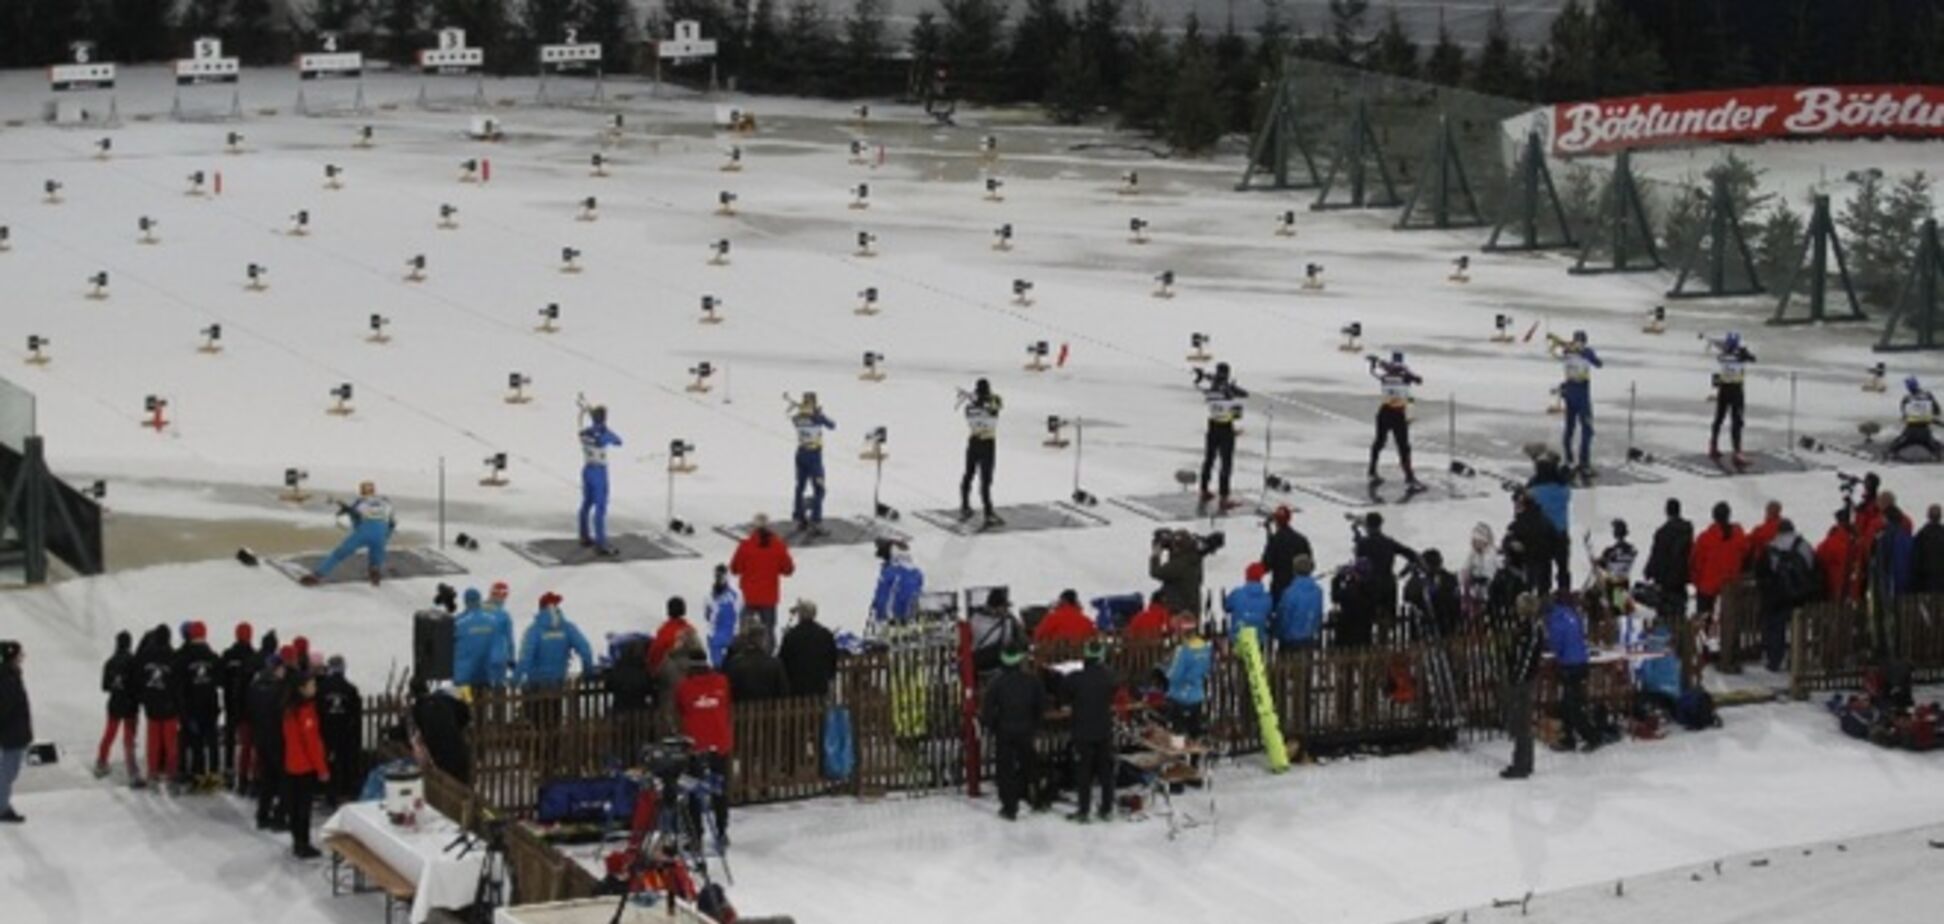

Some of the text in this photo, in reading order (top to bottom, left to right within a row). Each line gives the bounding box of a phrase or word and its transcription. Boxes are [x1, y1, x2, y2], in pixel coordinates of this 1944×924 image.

[446, 32, 457, 48] 3
[566, 28, 578, 44] 2
[682, 25, 690, 39] 1
[202, 42, 213, 57] 5
[323, 36, 336, 50] 4
[76, 46, 89, 62] 6
[1557, 99, 1777, 150] Böklunder
